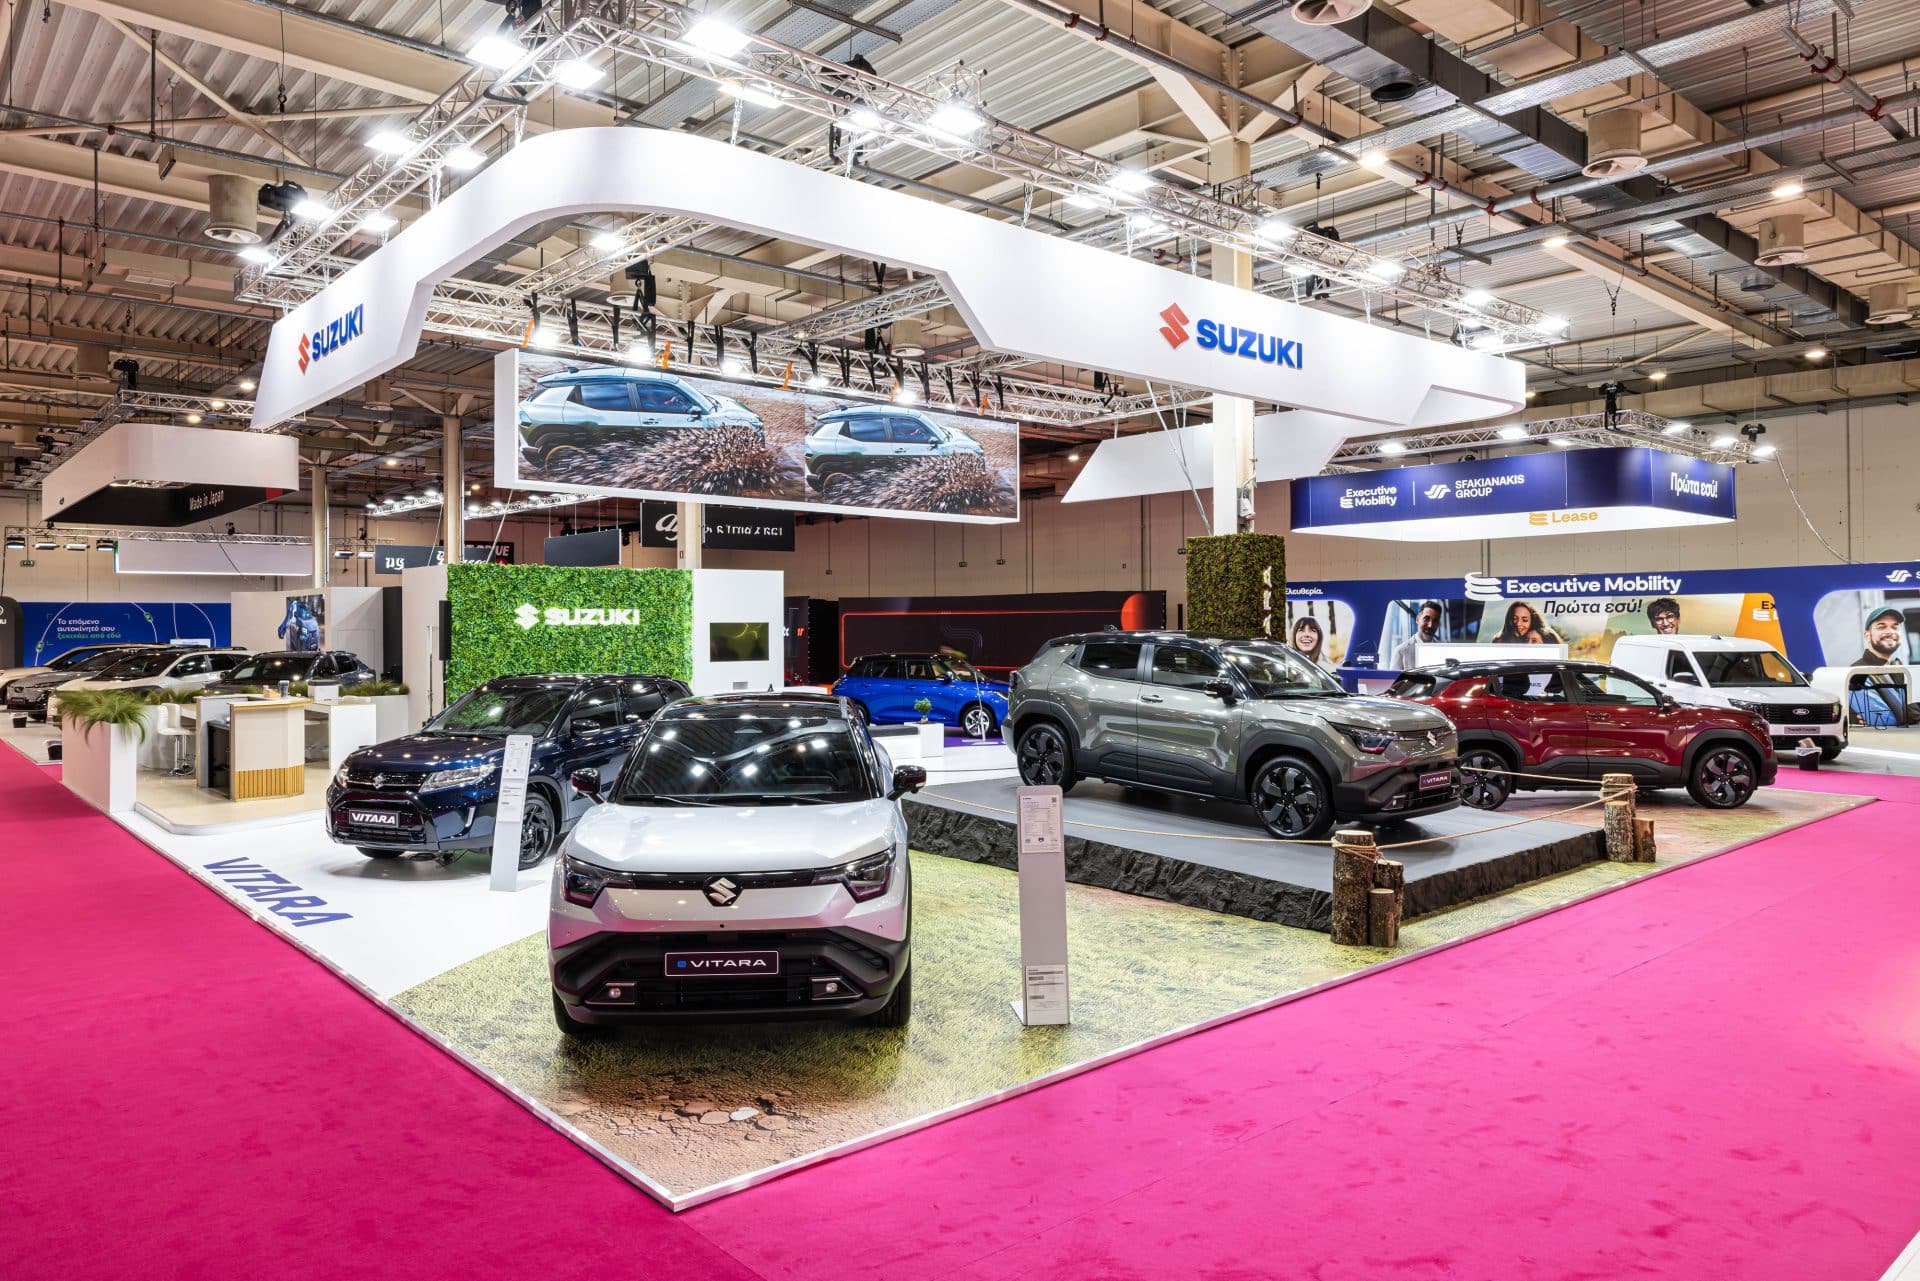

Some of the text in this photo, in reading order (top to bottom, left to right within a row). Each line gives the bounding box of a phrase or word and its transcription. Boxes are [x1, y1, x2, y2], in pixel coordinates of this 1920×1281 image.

[312, 303, 363, 362] SUZUKI
[1197, 318, 1303, 369] SUZUKI
[1455, 474, 1525, 489] SFAKIANAKIS
[1670, 472, 1718, 498] Πρώτα εσύ!
[1346, 485, 1397, 498] Executive
[1455, 487, 1493, 499] GROUP
[1354, 495, 1397, 507] Mobility
[1552, 511, 1599, 523] Lease
[1506, 575, 1682, 595] Executive Mobility
[1544, 598, 1643, 616] Πρώτα εσύ!
[544, 607, 640, 625] SUZUKI
[1426, 775, 1449, 784] VITARA
[352, 812, 395, 824] VITARA
[202, 856, 354, 928] VITARA
[690, 959, 767, 968] VITARA
